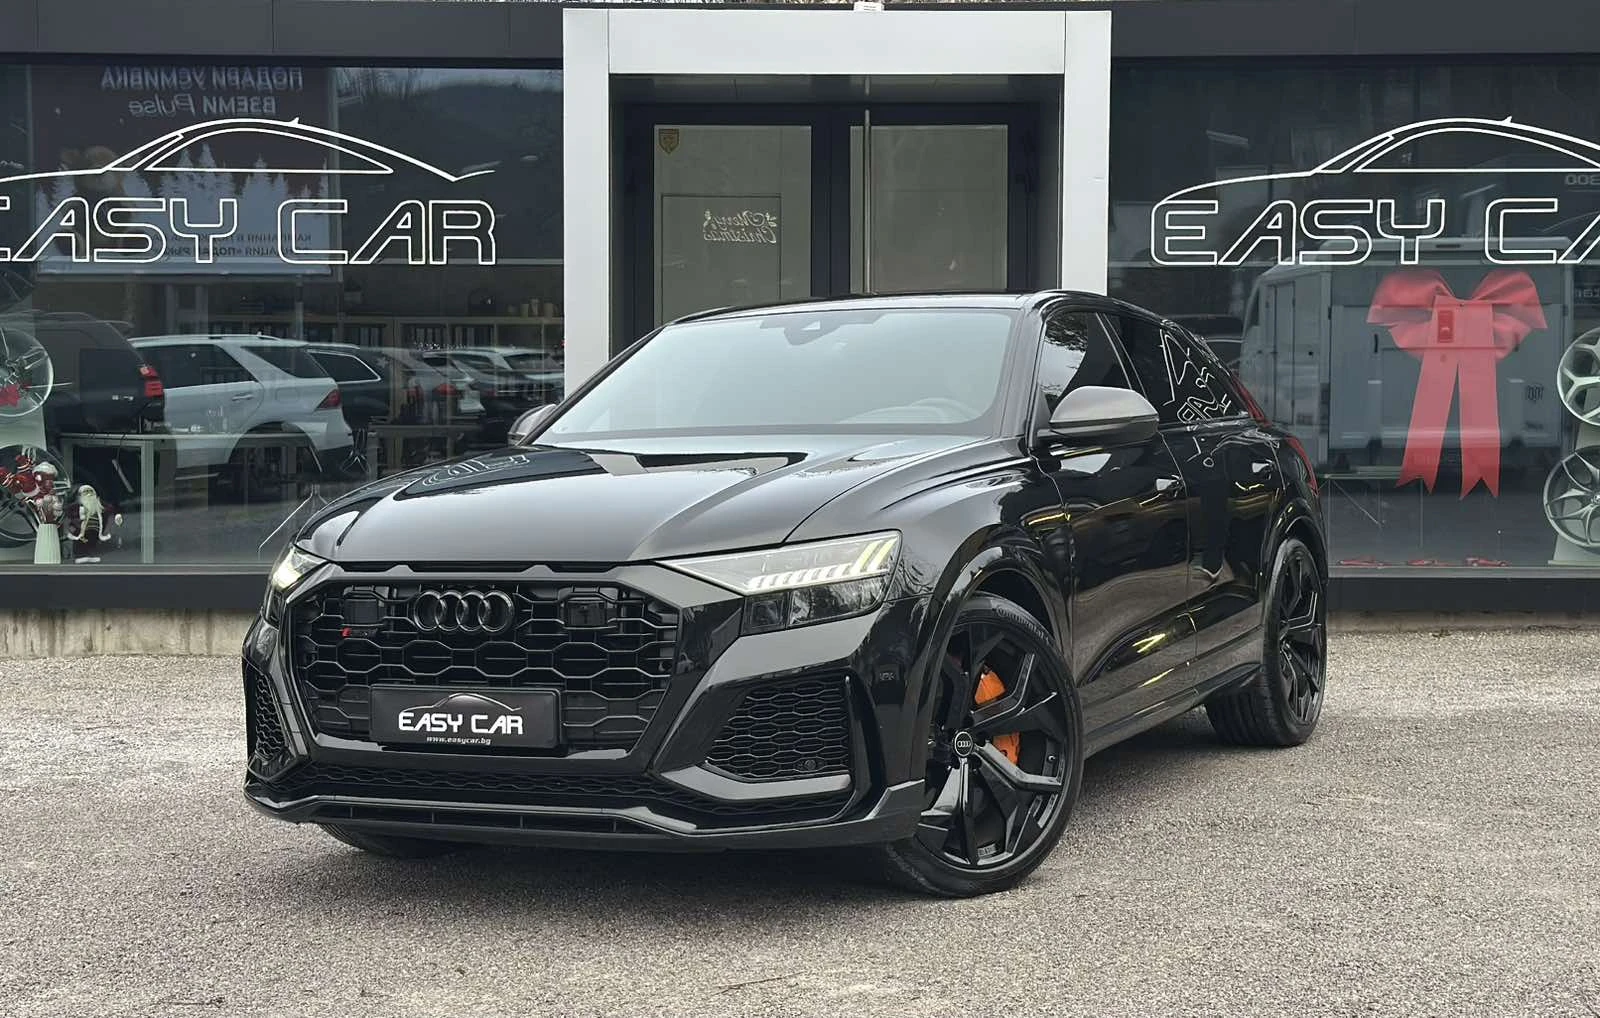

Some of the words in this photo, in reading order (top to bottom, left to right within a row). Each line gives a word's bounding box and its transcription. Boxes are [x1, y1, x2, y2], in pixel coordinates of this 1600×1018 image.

[0, 197, 238, 264] ASY
[278, 200, 496, 265] CAR
[1151, 199, 1446, 265] EASY
[398, 712, 463, 733] EASY
[470, 715, 523, 735] CAR
[426, 736, 492, 746] www.easycar.bg
